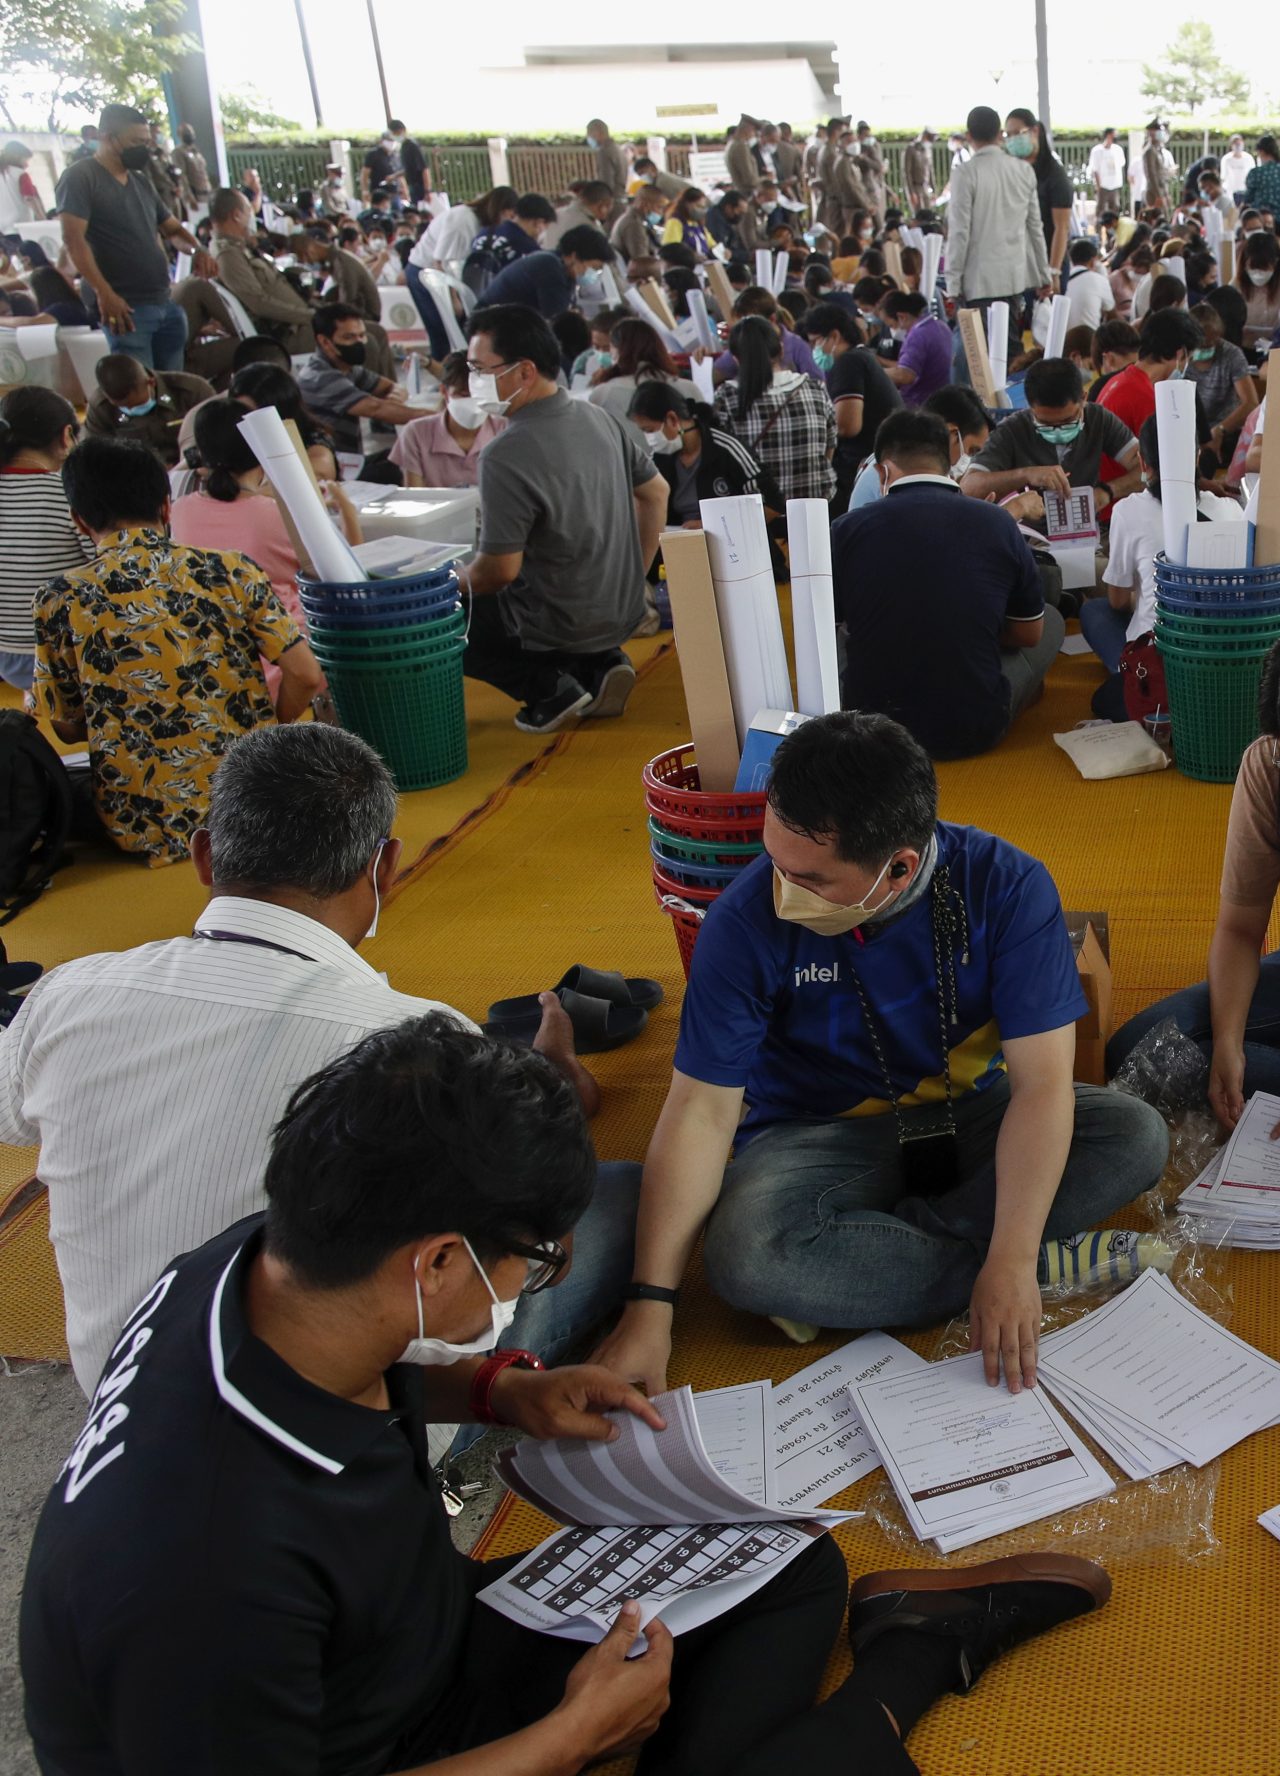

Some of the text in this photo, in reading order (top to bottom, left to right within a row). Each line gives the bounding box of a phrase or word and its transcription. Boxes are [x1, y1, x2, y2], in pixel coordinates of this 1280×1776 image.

[795, 962, 839, 987] intel
[812, 1364, 842, 1385] จำนวน
[855, 1354, 894, 1383] เลขที่บัตร
[798, 1383, 812, 1393] 28
[815, 1382, 853, 1407] 389121
[776, 1431, 813, 1454] 169484
[816, 1426, 864, 1456] น่วยที่ 21
[777, 1452, 868, 1507] แขวงถนนเพชรบุ
[571, 1532, 583, 1540] 5
[640, 1527, 653, 1536] 11
[622, 1538, 637, 1550] 12
[691, 1534, 706, 1545] 18
[555, 1545, 566, 1554] 6
[676, 1547, 690, 1558] 19
[743, 1542, 760, 1553] 25
[605, 1552, 620, 1564] 13
[727, 1556, 744, 1566] 26
[536, 1560, 549, 1569] 7
[658, 1561, 674, 1573] 20
[588, 1566, 603, 1579] 14
[519, 1575, 531, 1584] 8
[641, 1576, 657, 1586] 21
[571, 1581, 586, 1593] 15
[623, 1588, 640, 1598] 22
[553, 1595, 569, 1607] 16
